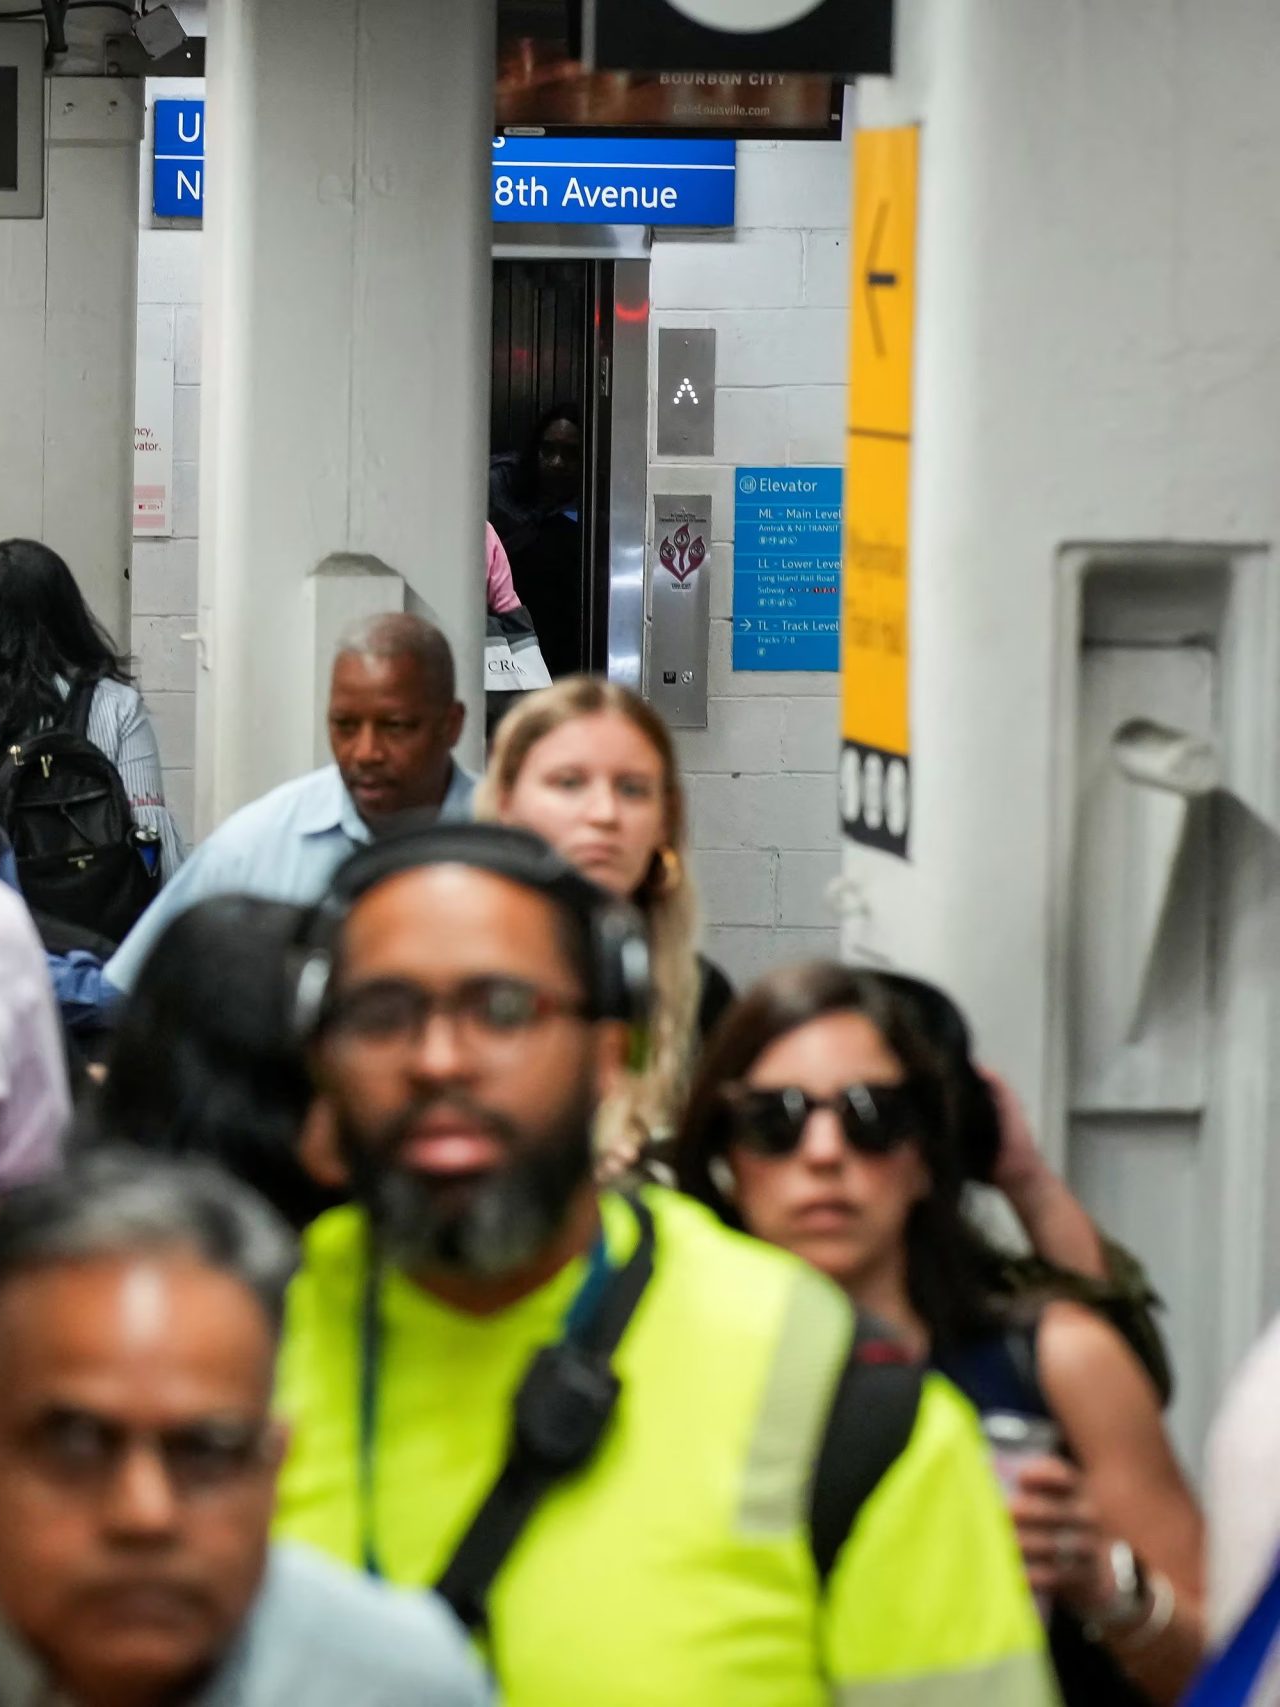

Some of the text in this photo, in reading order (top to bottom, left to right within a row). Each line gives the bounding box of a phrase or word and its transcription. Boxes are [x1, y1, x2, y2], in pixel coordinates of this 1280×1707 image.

[659, 72, 786, 86] BOURBON CITY
[178, 112, 201, 143] U
[177, 170, 678, 209] N 8th Avenue
[759, 477, 818, 492] Elevator
[759, 508, 773, 519] ML
[786, 508, 812, 520] Main
[815, 508, 842, 520] Level
[758, 558, 769, 569] LL
[781, 558, 812, 569] Lower
[816, 558, 843, 570] Level
[758, 620, 769, 631] TL
[782, 620, 809, 631] Track
[812, 620, 839, 631] Level
